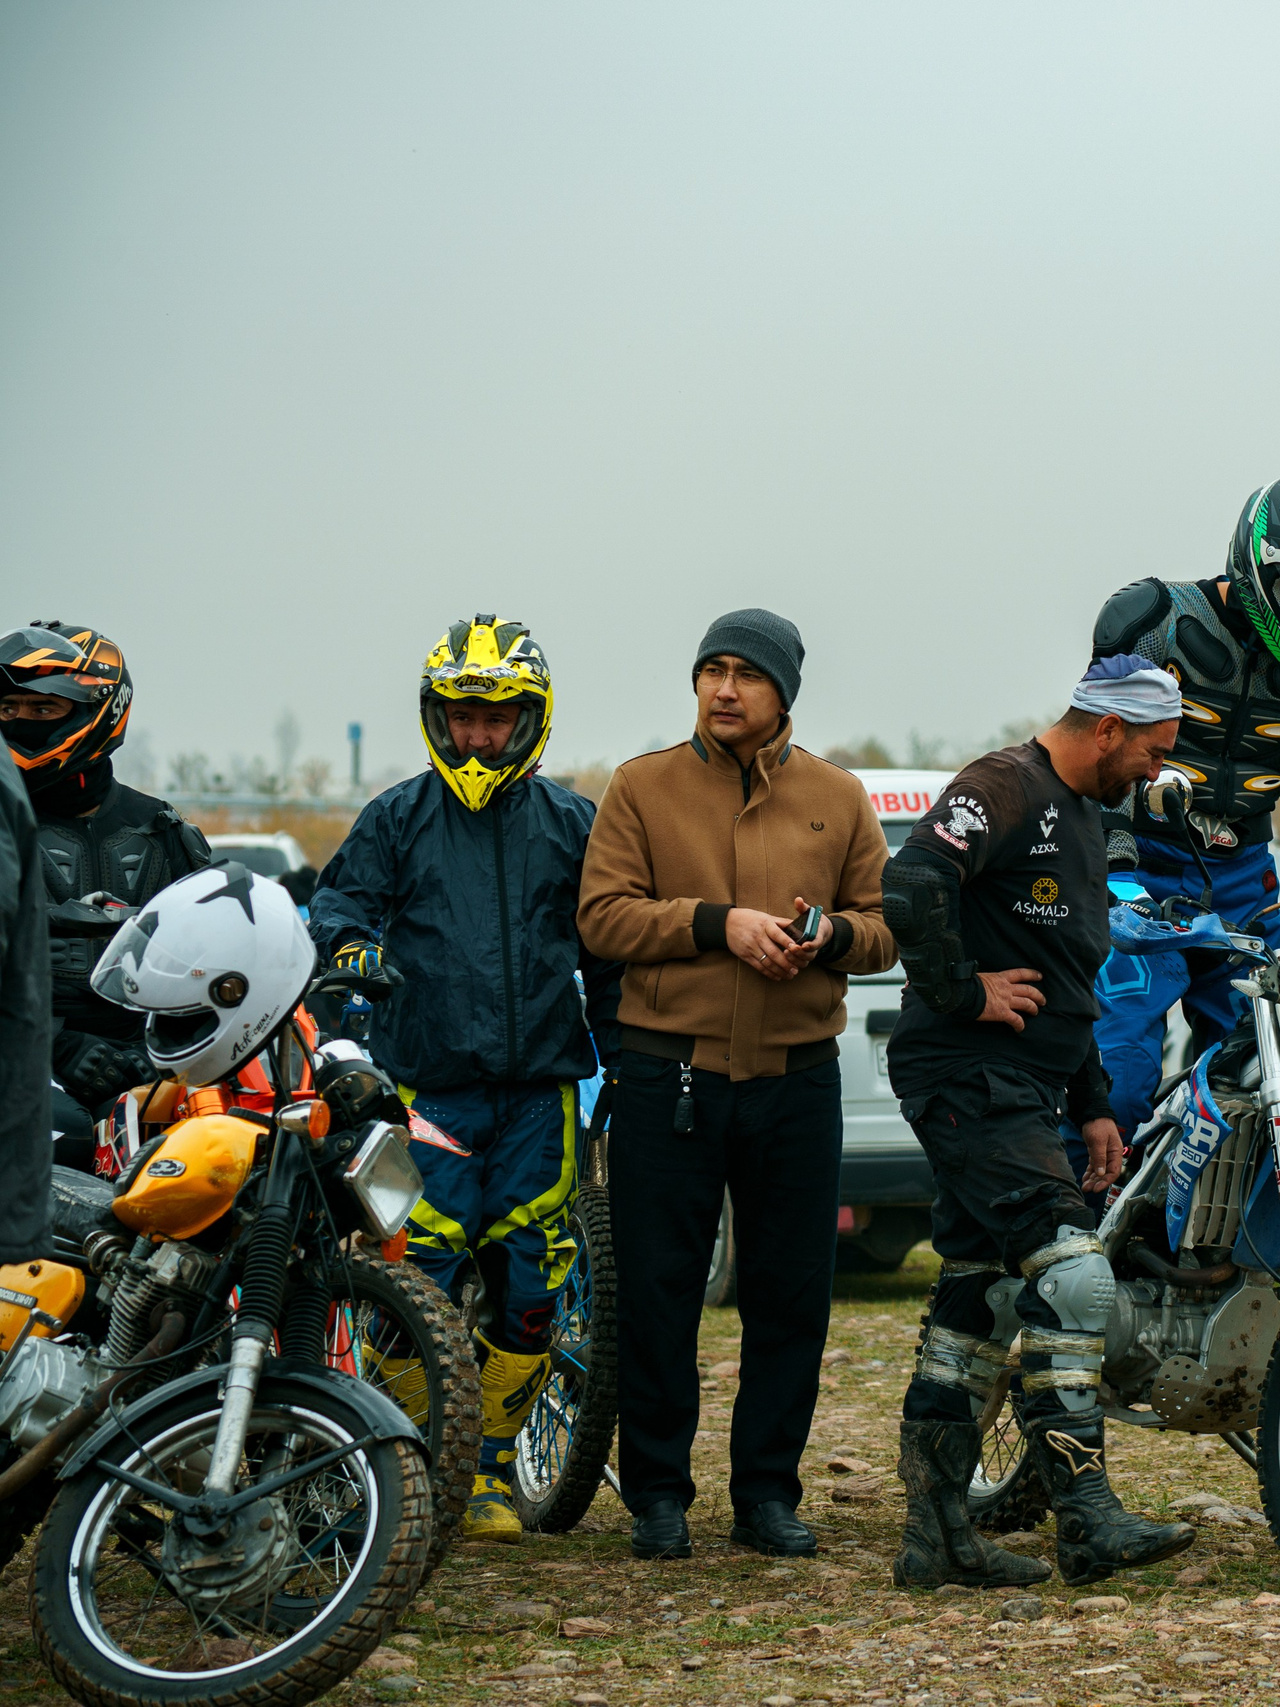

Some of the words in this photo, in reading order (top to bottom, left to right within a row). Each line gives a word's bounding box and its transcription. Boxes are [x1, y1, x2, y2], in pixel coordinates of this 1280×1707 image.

[1210, 833, 1232, 845] VEGA
[1120, 900, 1151, 915] THOR
[1025, 917, 1058, 926] PALACE
[1181, 1145, 1203, 1165] 250
